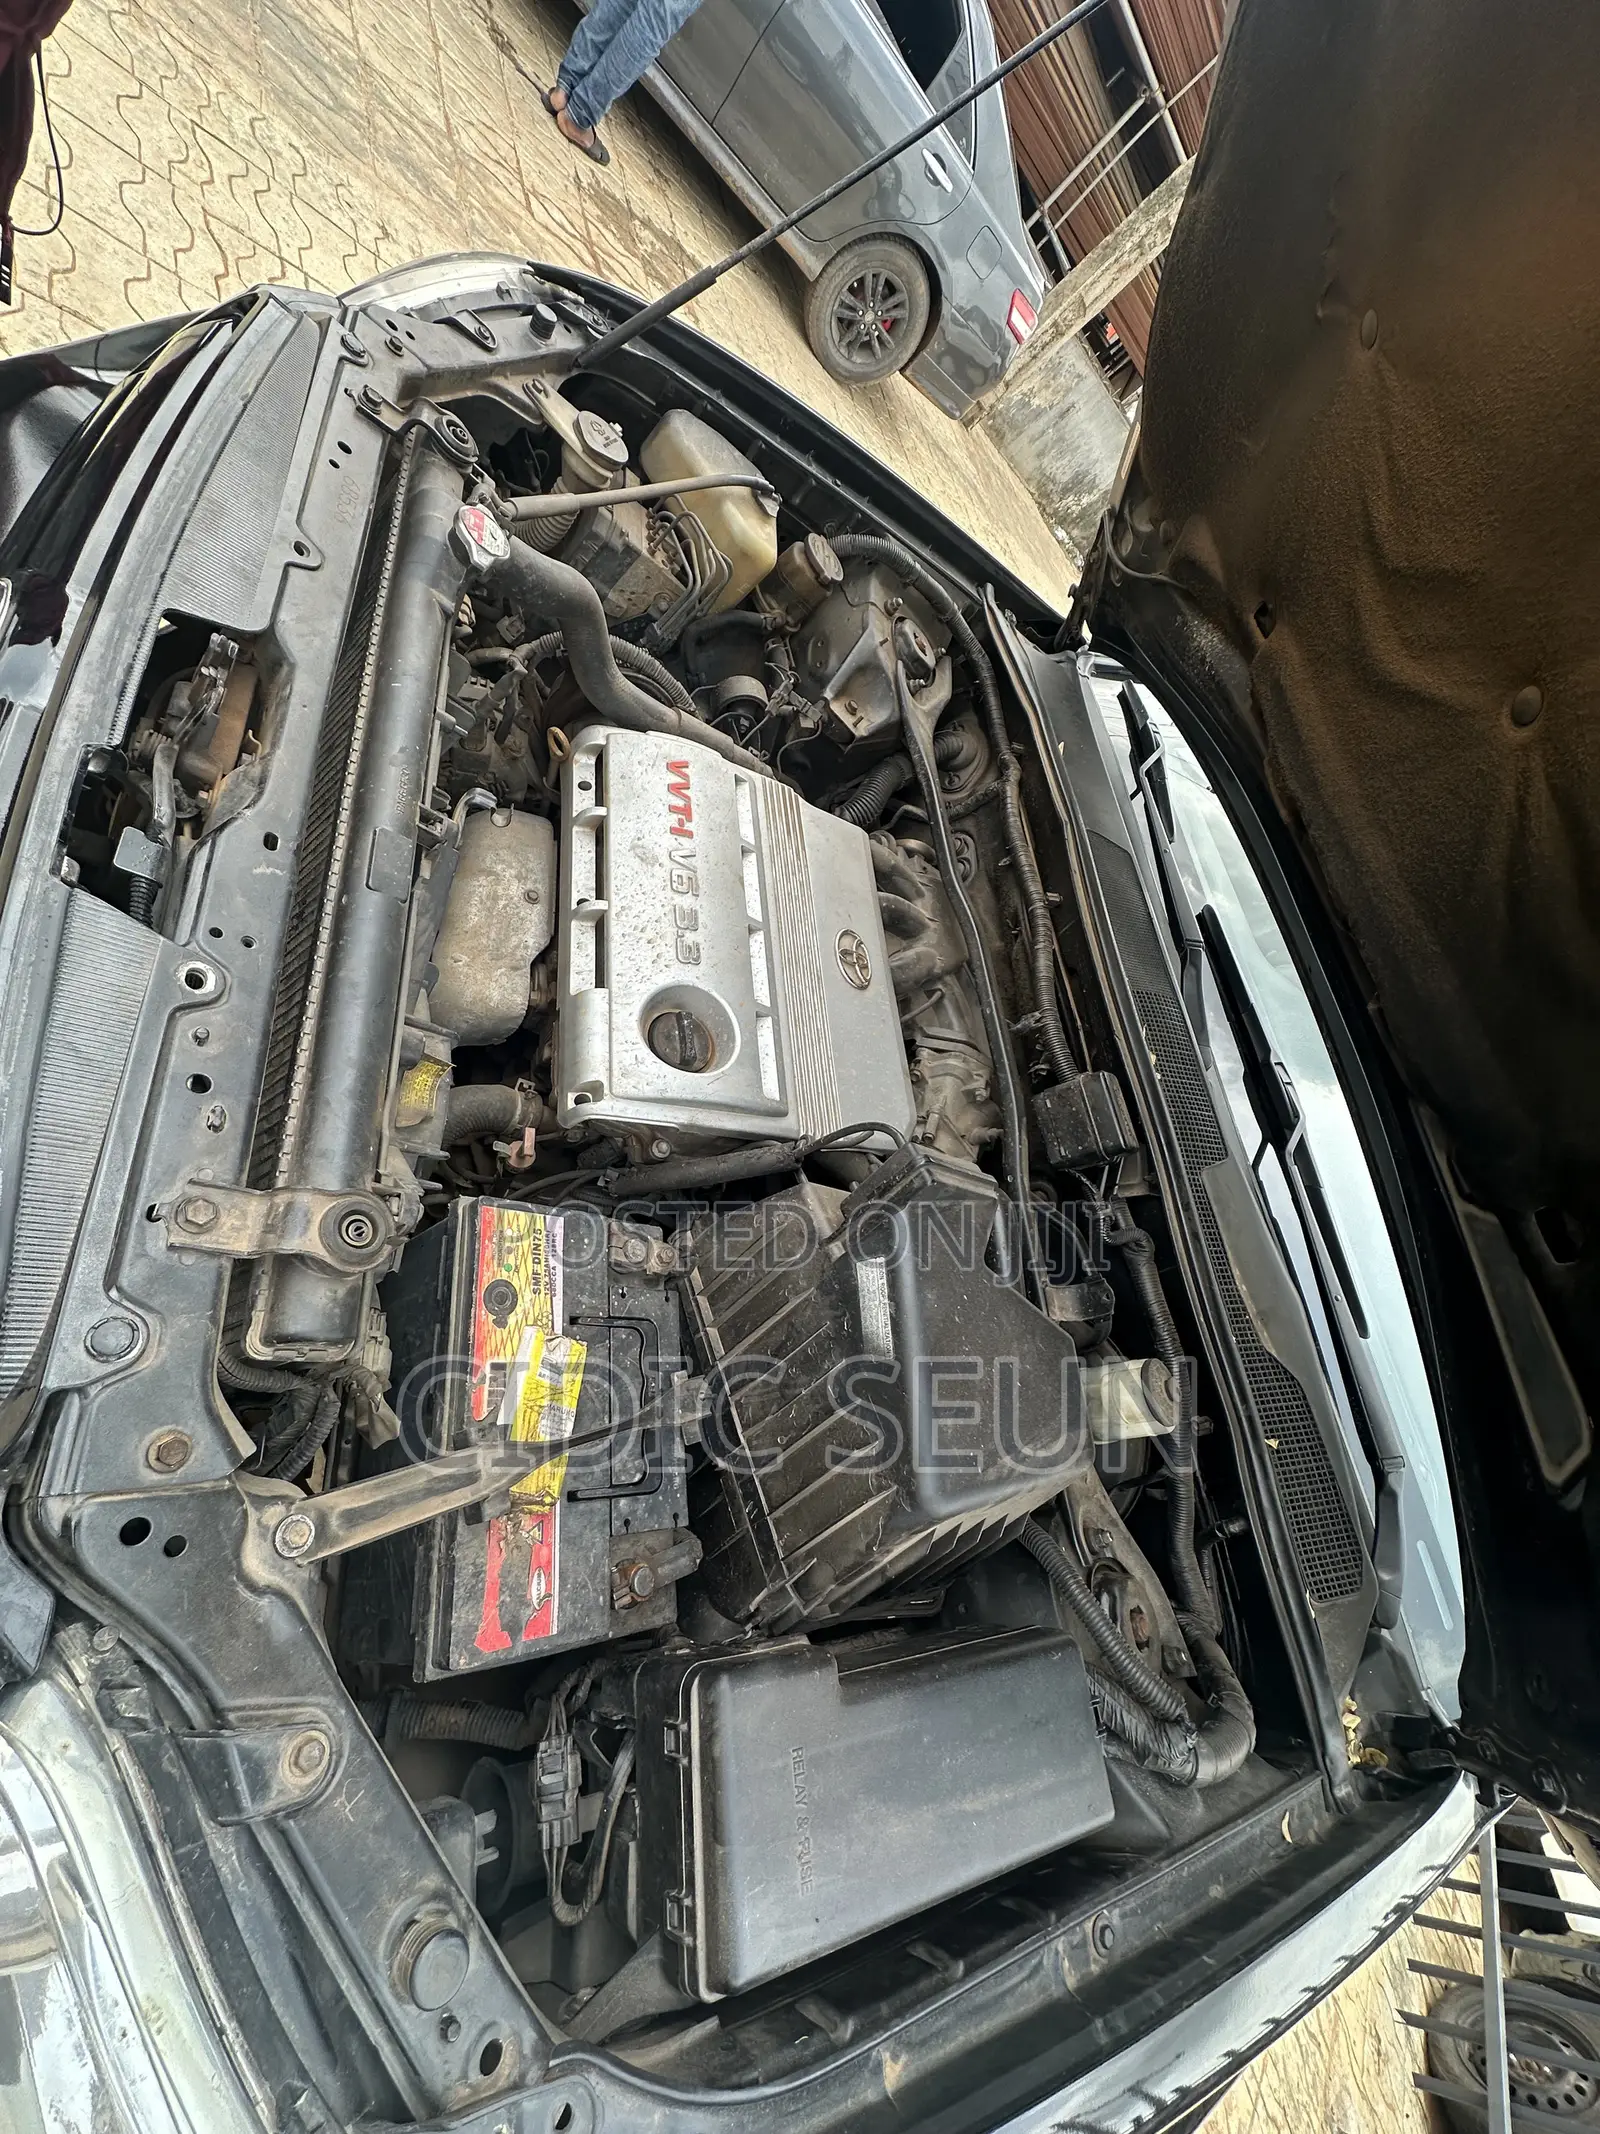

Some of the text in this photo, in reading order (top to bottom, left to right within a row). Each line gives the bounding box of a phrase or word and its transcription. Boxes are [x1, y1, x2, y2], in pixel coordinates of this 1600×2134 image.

[669, 847, 700, 897] V6
[673, 904, 702, 965] 3.3
[532, 1228, 543, 1296] SMF DIN75
[791, 1746, 814, 1897] RELAY & FUSE
